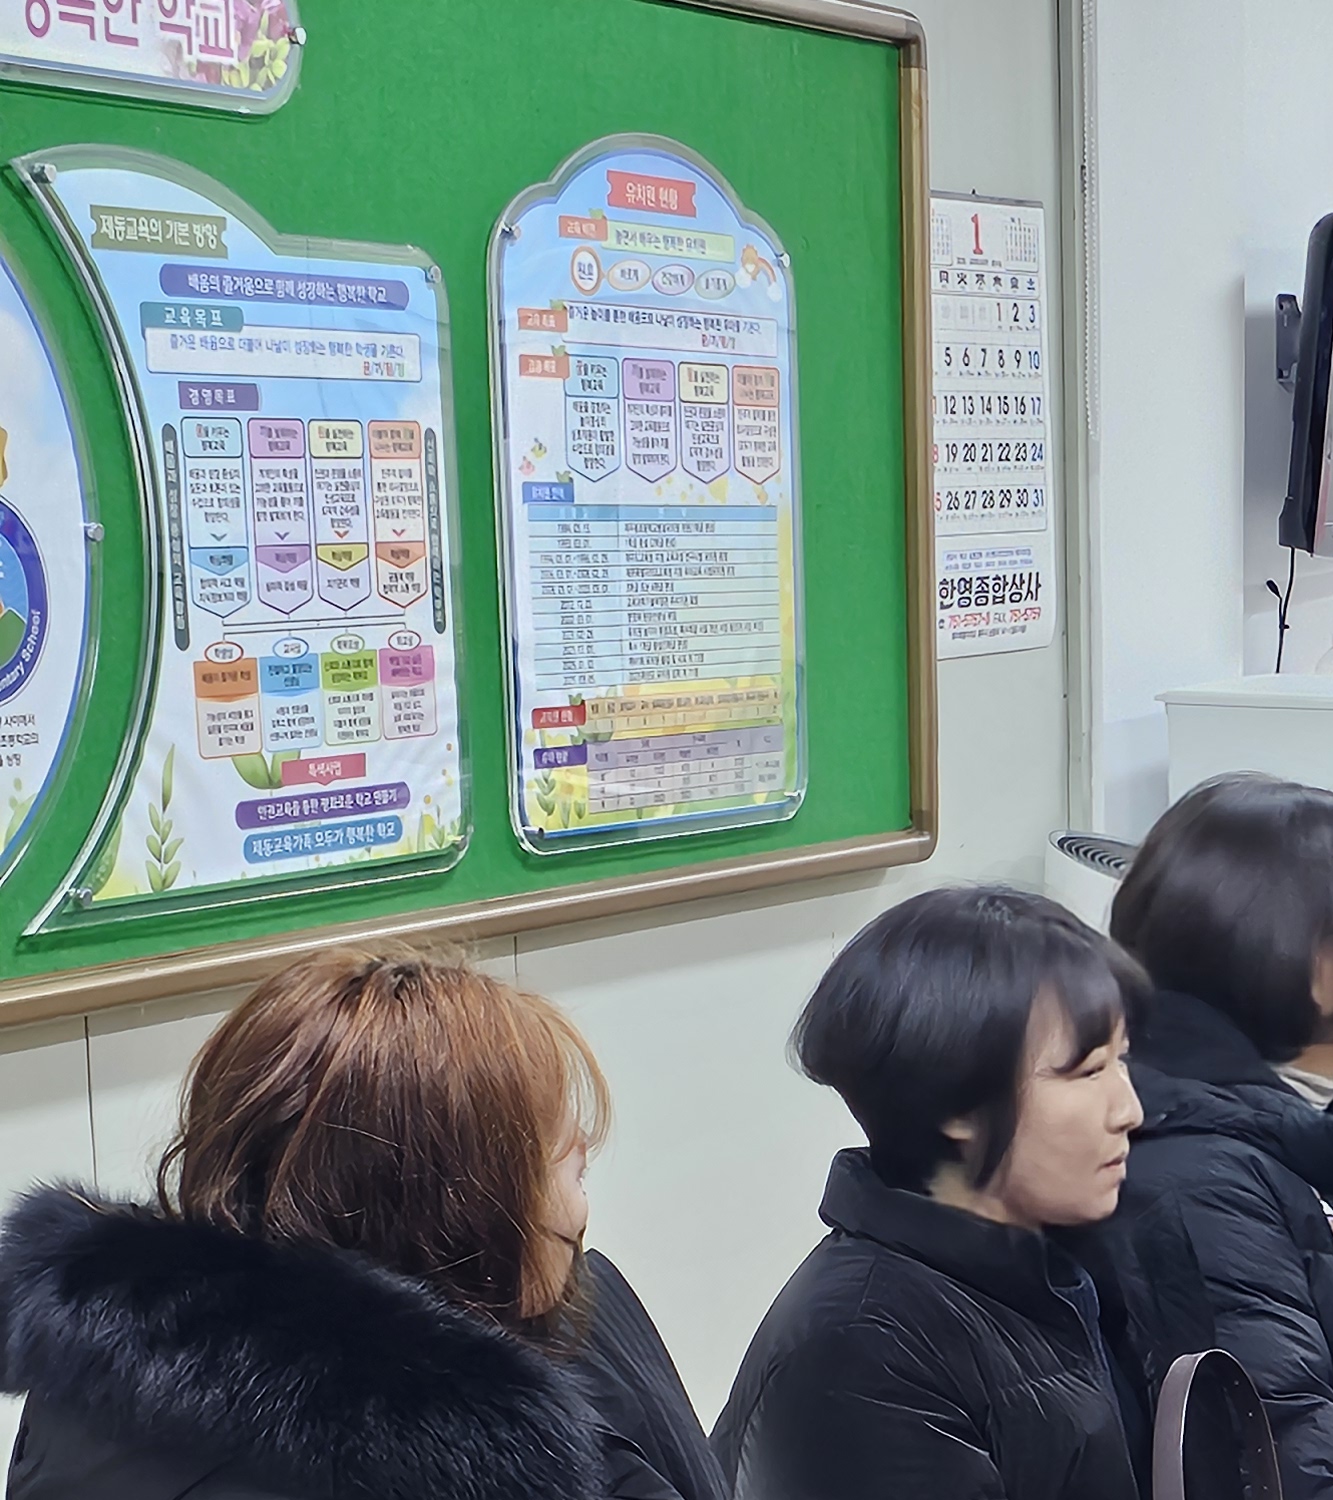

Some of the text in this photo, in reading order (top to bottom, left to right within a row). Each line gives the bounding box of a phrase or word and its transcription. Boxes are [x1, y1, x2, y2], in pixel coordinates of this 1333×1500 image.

[165, 220, 190, 246] 기본
[193, 223, 218, 249] 방향
[971, 213, 984, 255] 1
[1012, 302, 1020, 322] 2
[1029, 304, 1036, 323] 3
[944, 347, 1040, 370] 5 6 7 8 9 10
[944, 395, 956, 415] 12
[962, 395, 974, 415] 13
[980, 395, 992, 415] 14
[998, 395, 1009, 415] 15
[1014, 396, 1026, 415] 16
[1031, 397, 1041, 415] 17
[945, 443, 958, 463] 19
[962, 443, 977, 463] 20
[981, 443, 993, 462] 21
[997, 443, 1011, 462] 22
[1015, 443, 1027, 461] 23
[1031, 443, 1043, 461] 24
[946, 491, 960, 510] 26
[964, 490, 977, 510] 27
[981, 490, 995, 509] 28
[998, 489, 1012, 508] 29
[1015, 489, 1029, 507] 30
[1033, 488, 1044, 507] 31
[938, 572, 1042, 610] 한영종합상사
